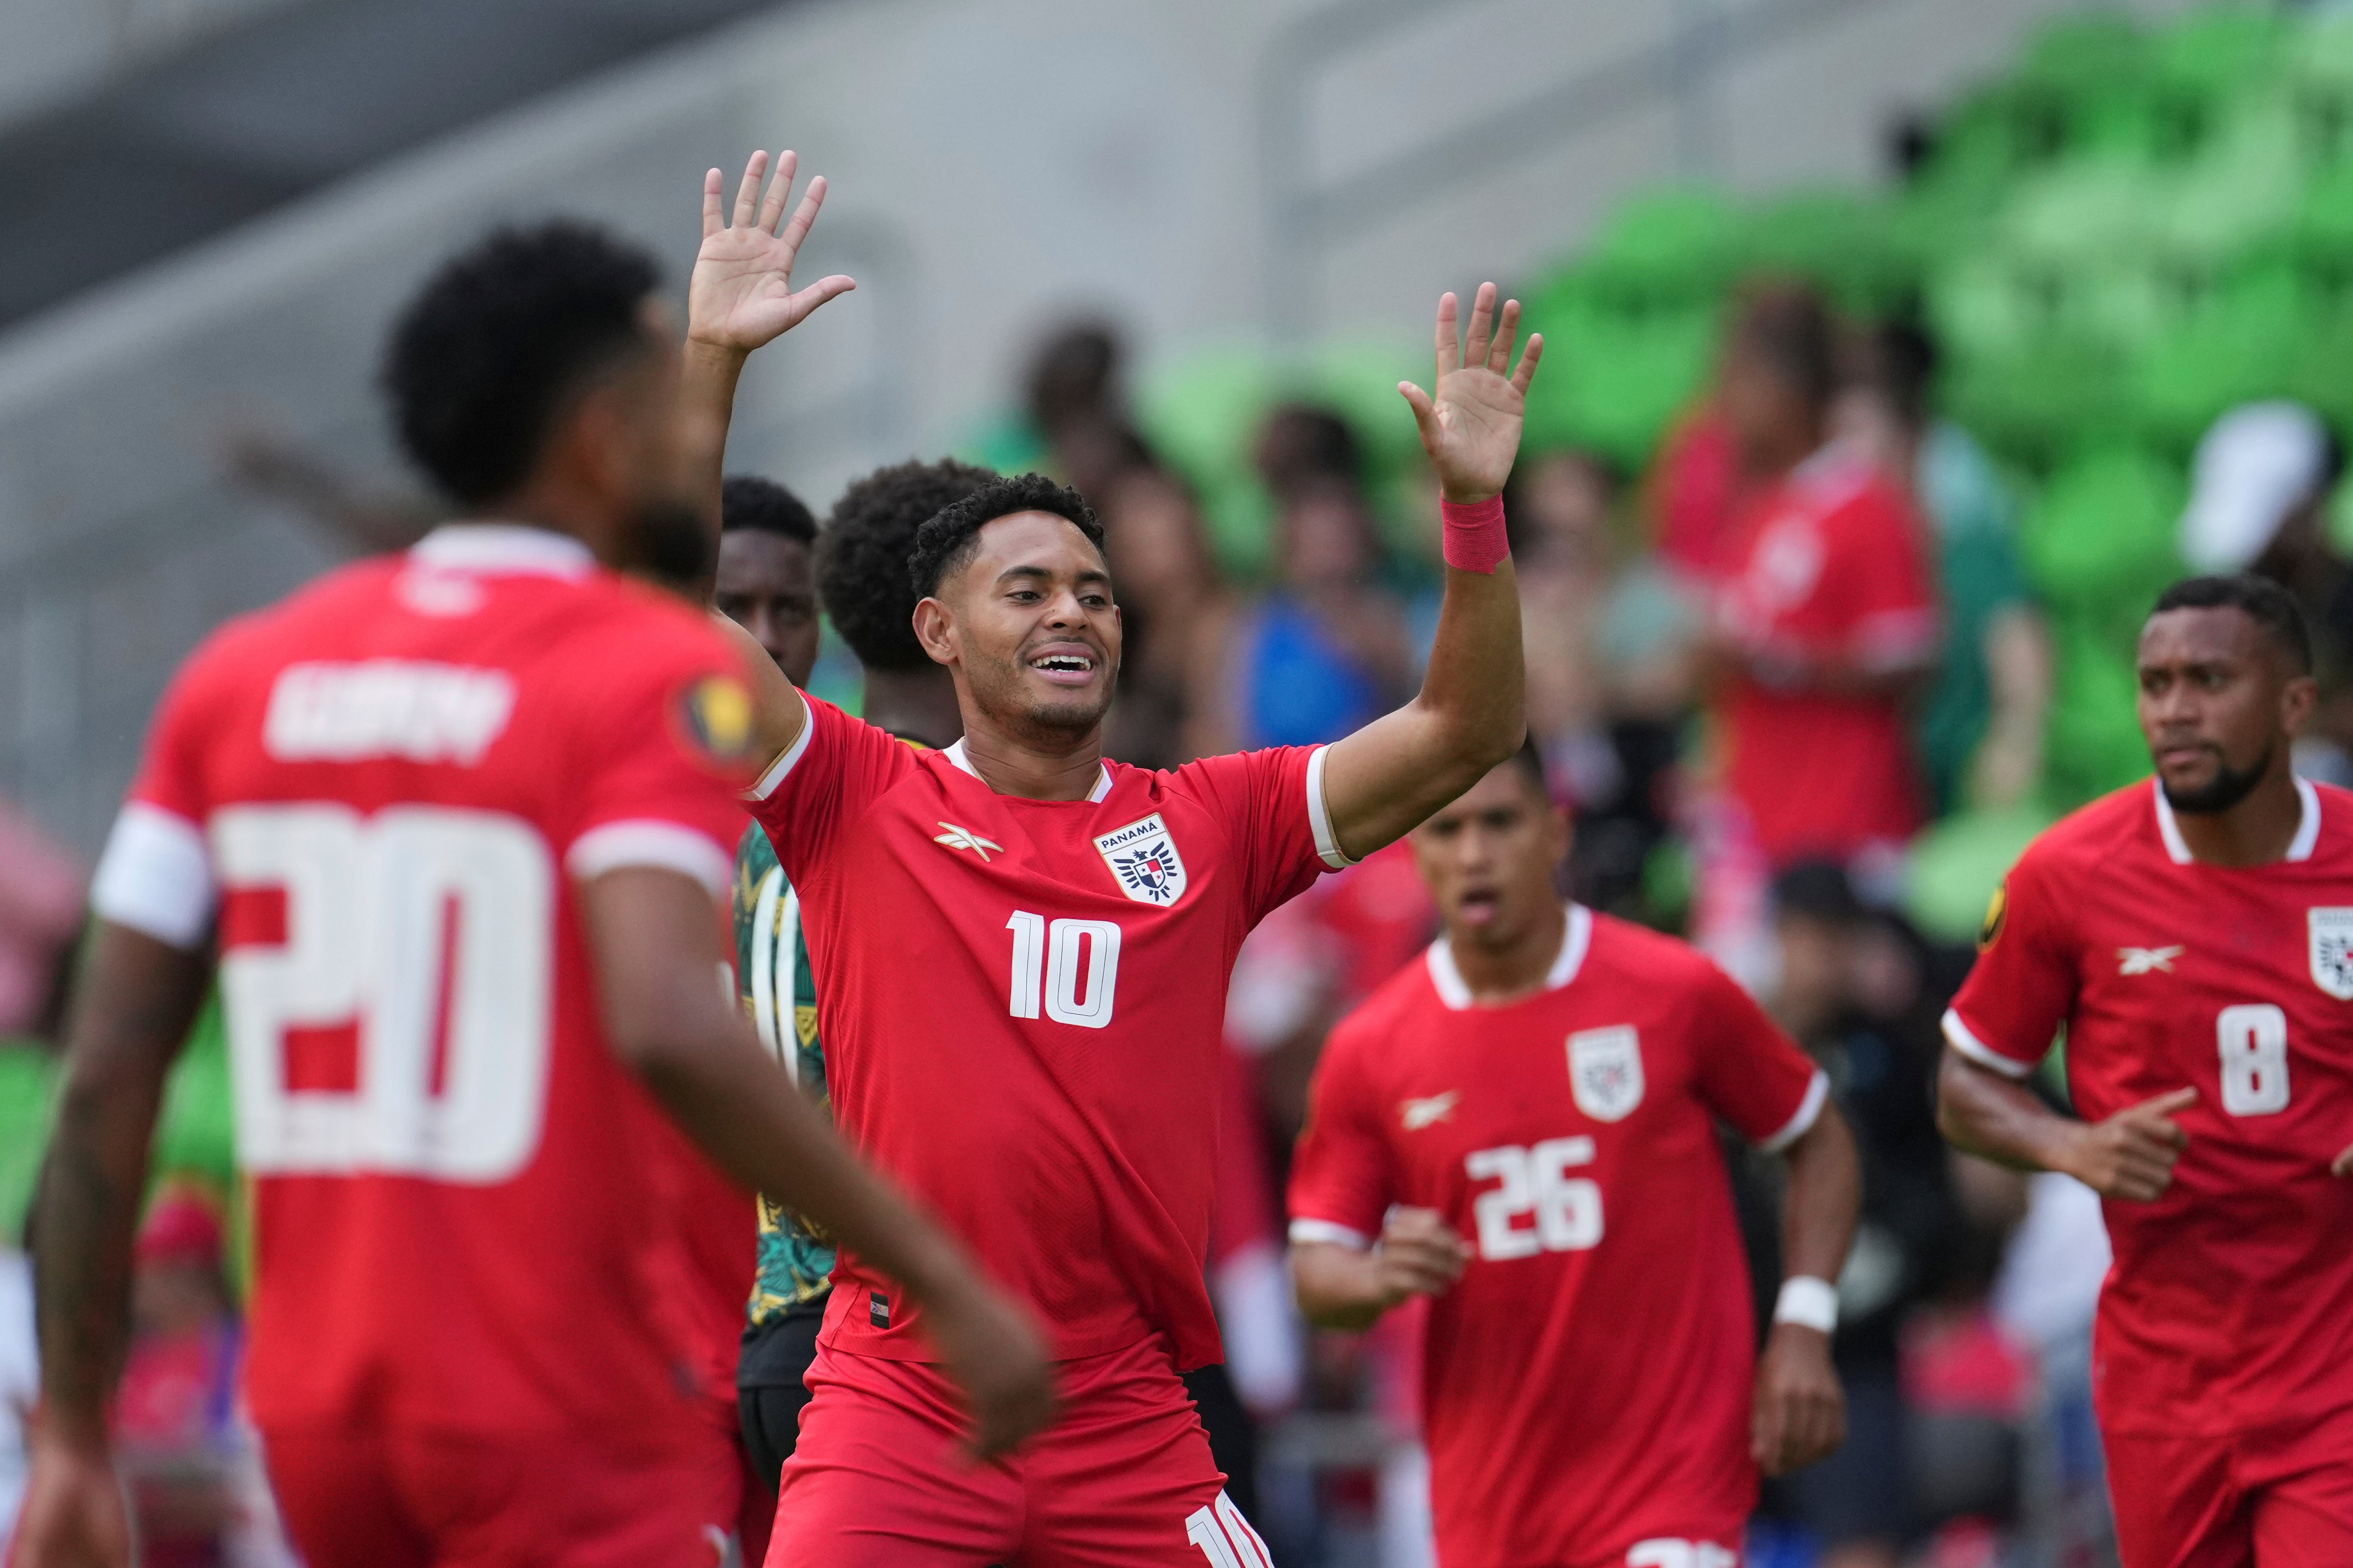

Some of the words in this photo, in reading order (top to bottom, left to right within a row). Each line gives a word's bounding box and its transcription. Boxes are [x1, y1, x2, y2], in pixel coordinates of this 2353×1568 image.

[1101, 820, 1158, 849] PANAMÁ
[210, 799, 557, 1187] 20
[1005, 910, 1121, 1029] 10
[2217, 1003, 2290, 1116] 8
[1464, 1134, 1605, 1261] 26
